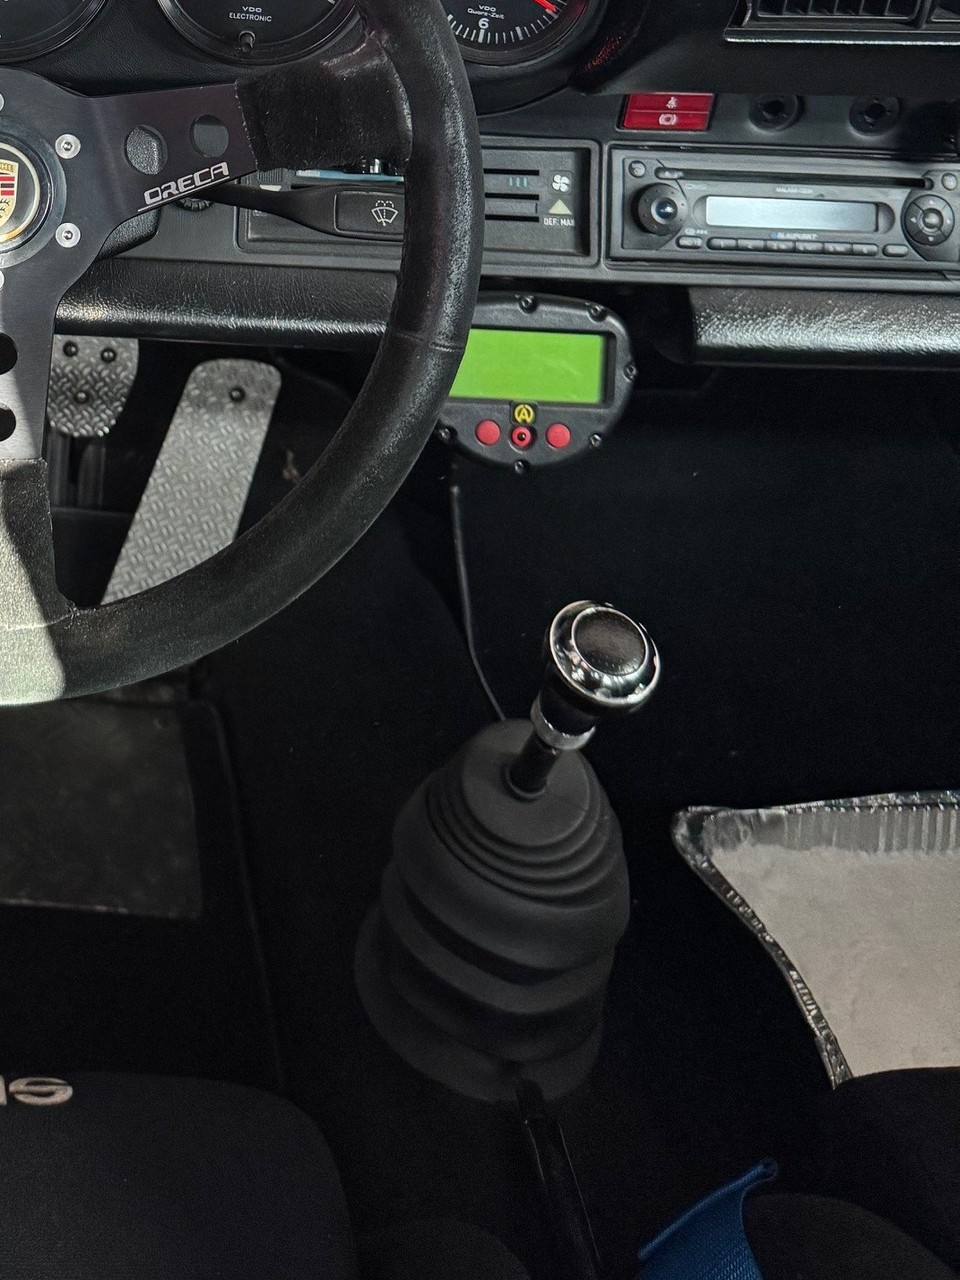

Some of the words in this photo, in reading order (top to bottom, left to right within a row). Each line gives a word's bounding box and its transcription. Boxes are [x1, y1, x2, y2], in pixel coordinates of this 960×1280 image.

[478, 4, 497, 12] VDO
[229, 12, 272, 22] ELECTRONIC
[478, 17, 489, 29] 6
[144, 161, 230, 206] ORECA
